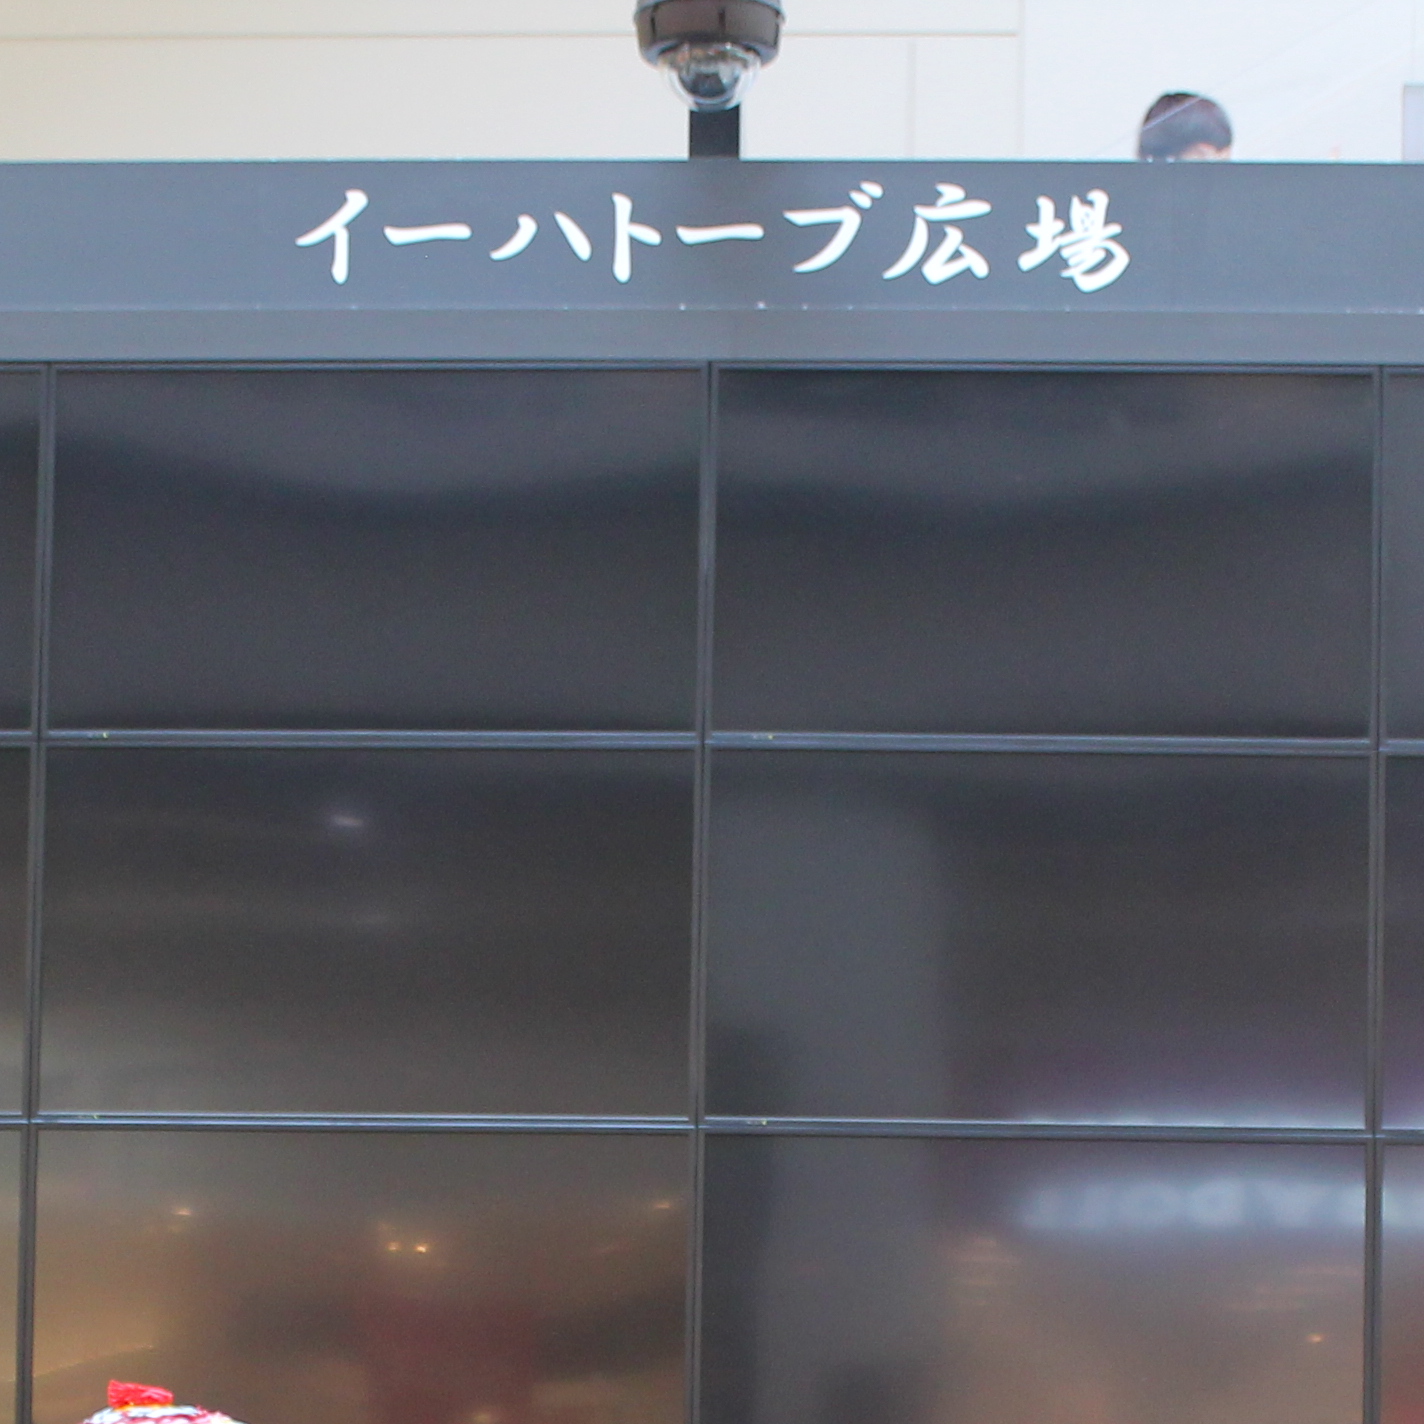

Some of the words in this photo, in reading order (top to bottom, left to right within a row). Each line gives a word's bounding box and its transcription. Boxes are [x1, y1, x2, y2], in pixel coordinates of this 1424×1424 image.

[295, 182, 1131, 292] イーハトーブ広場
